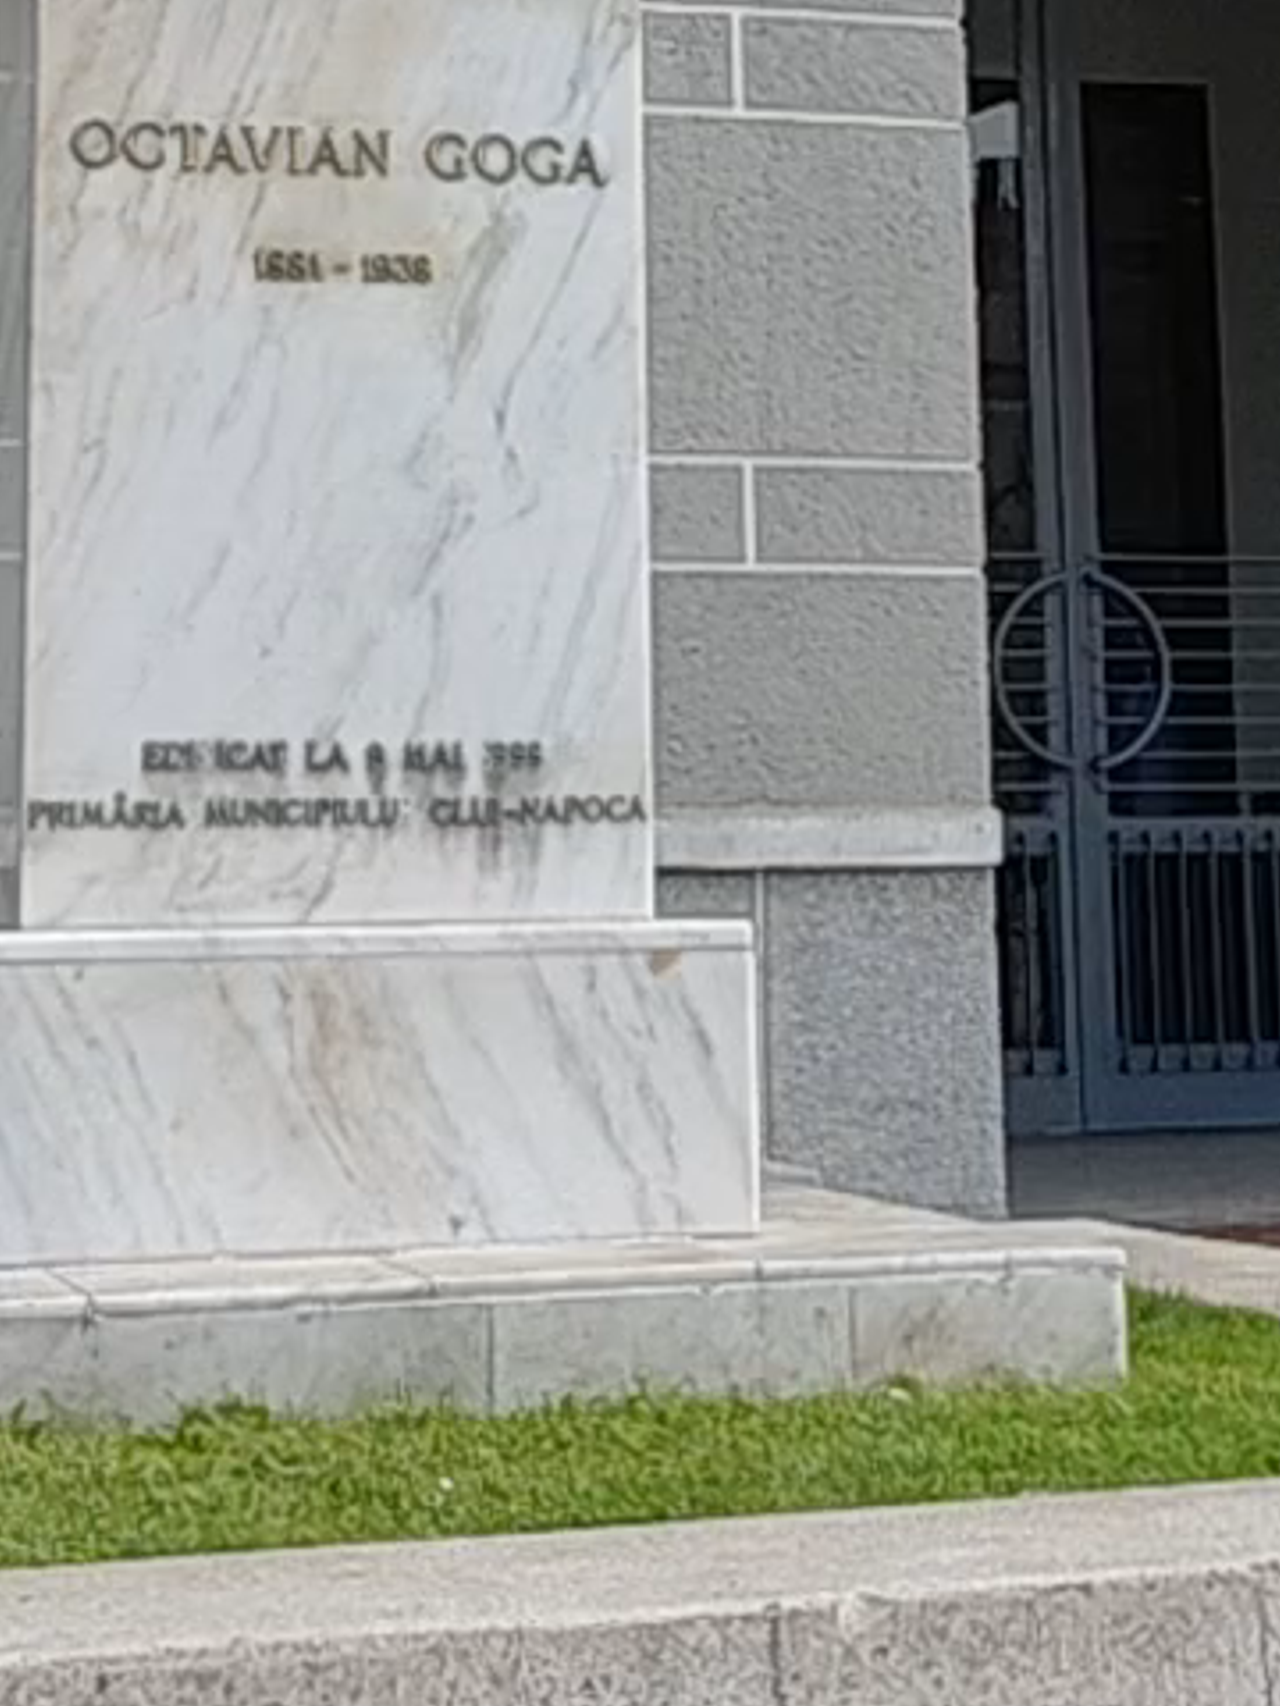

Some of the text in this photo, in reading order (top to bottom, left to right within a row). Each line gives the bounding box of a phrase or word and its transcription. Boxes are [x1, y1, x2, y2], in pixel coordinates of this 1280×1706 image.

[68, 119, 608, 188] OCTAVIAN GOGA
[141, 738, 287, 773] EDIICAT
[305, 738, 349, 773] LA
[205, 795, 410, 828] MUNICIPIULU
[428, 793, 647, 827] CLUJ-NAPOCA
